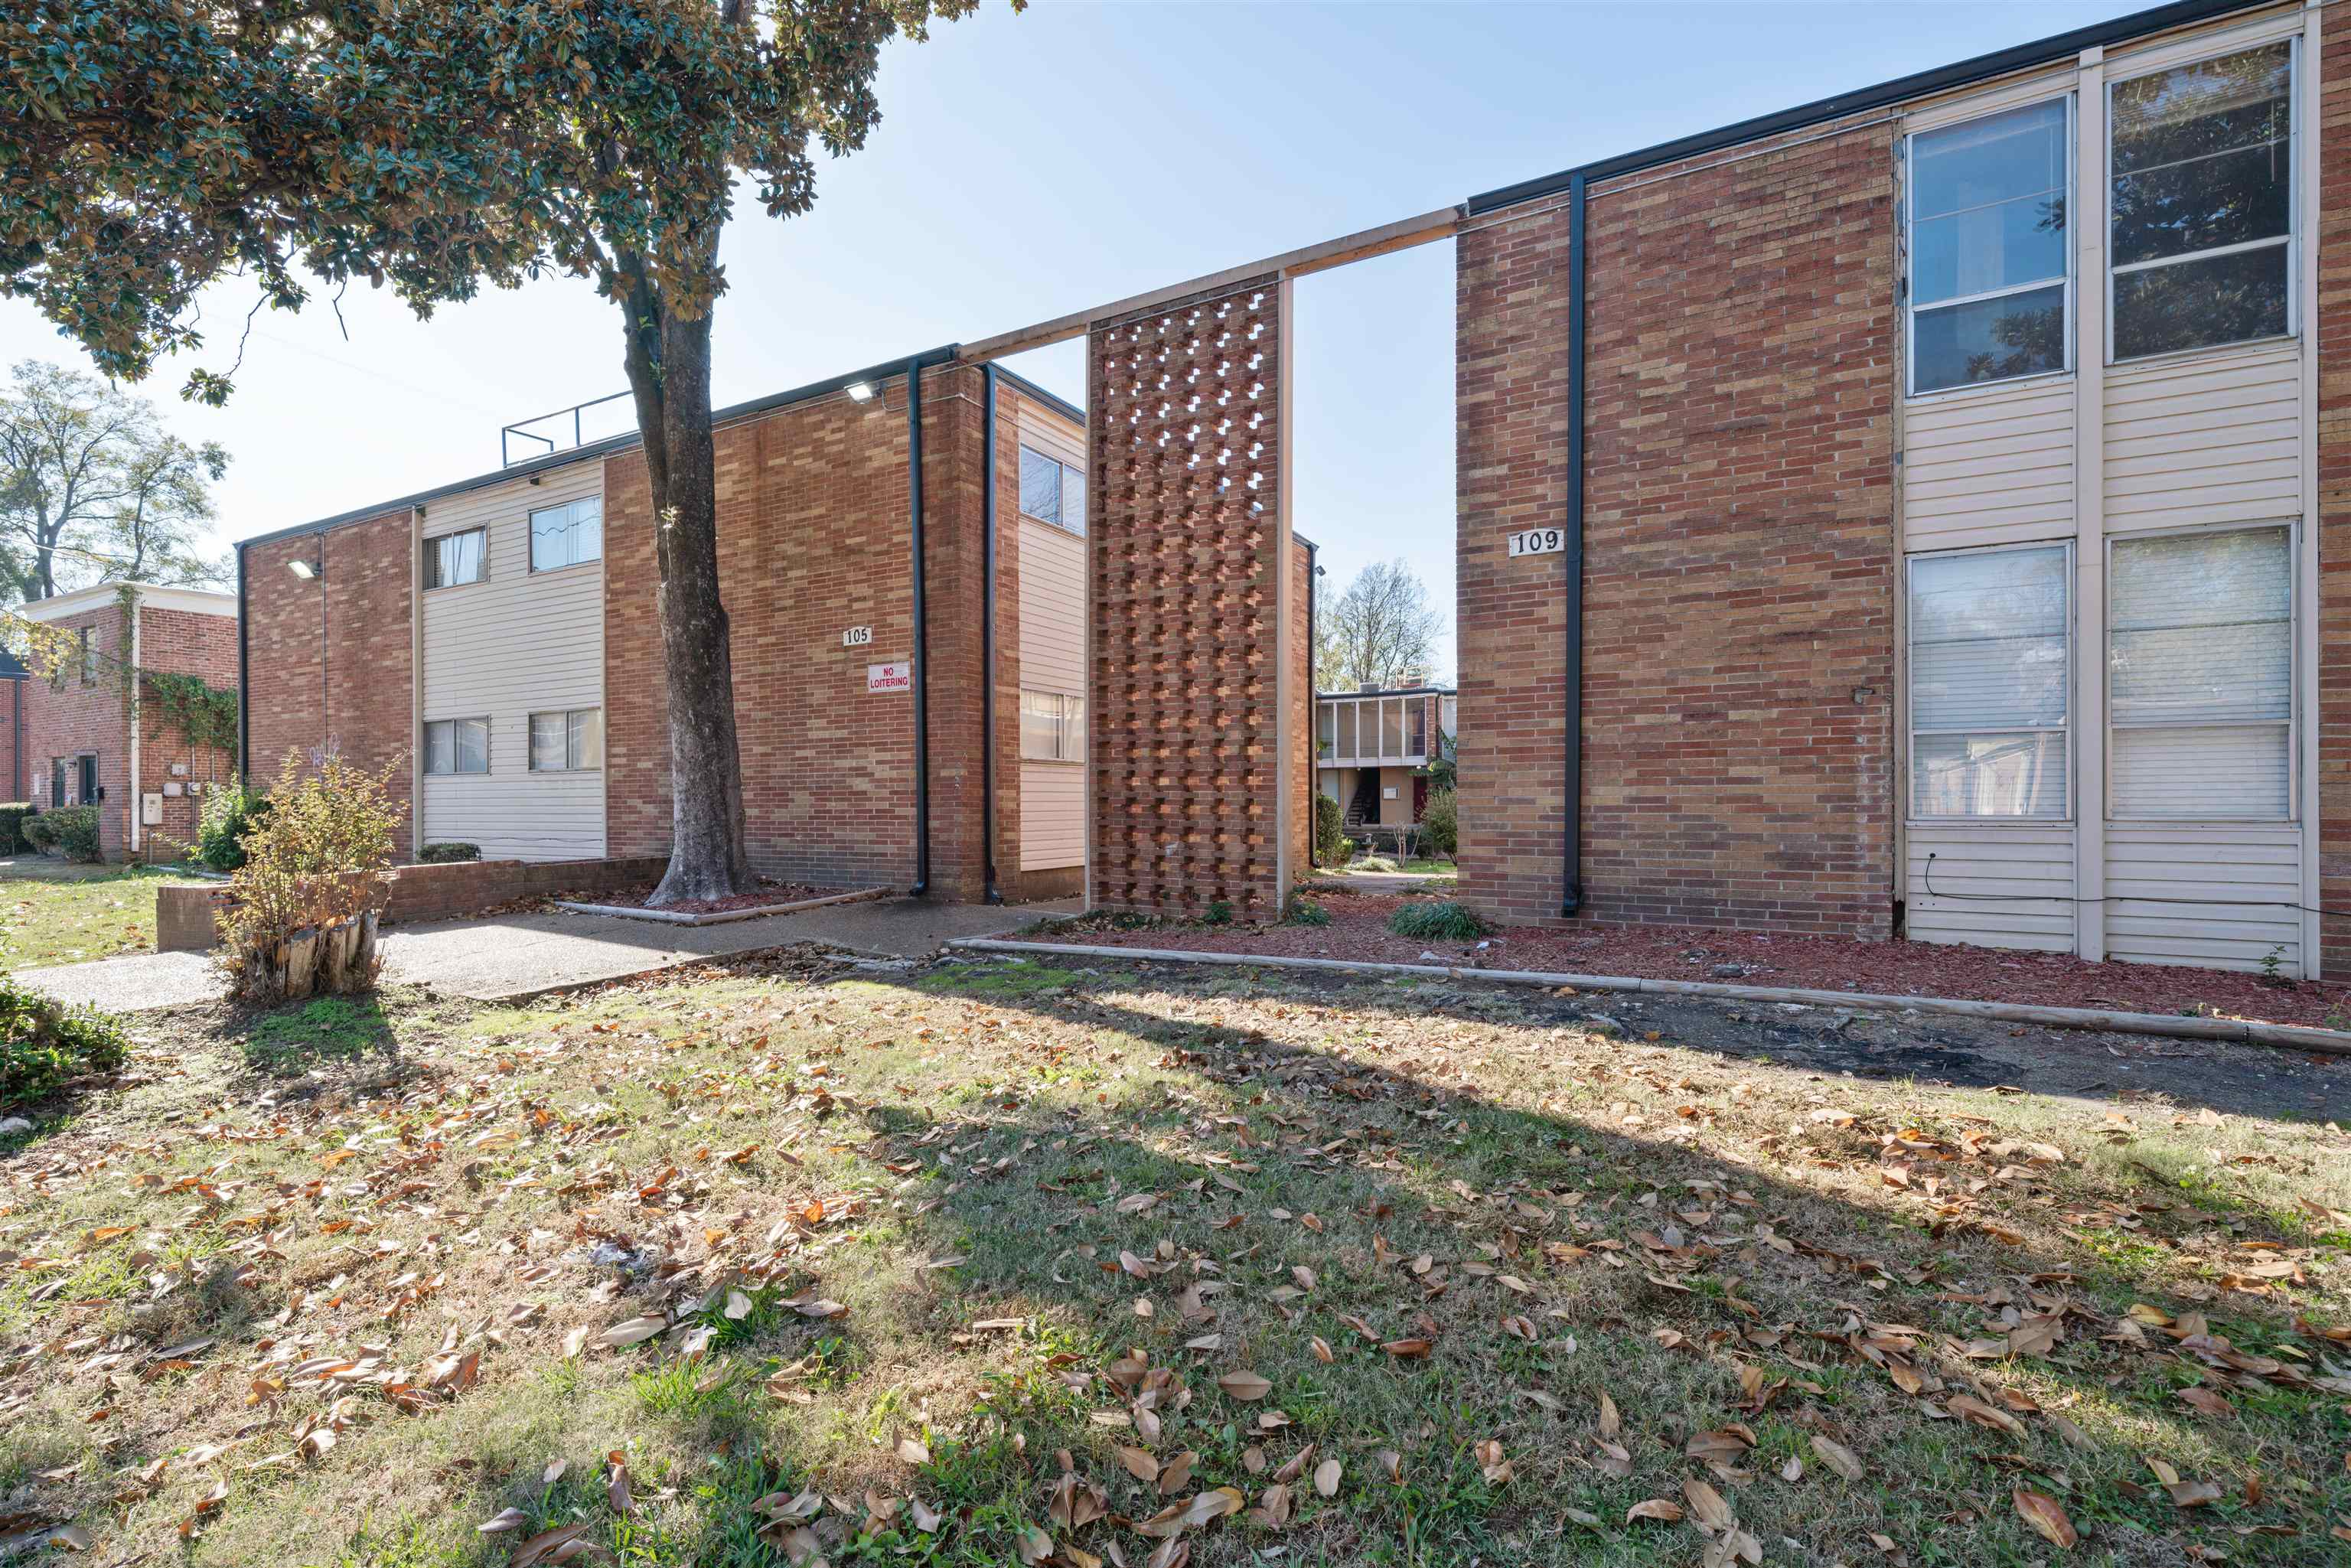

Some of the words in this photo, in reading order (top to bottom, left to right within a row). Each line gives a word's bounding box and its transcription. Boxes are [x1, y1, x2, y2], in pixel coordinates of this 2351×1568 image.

[1518, 530, 1558, 553] 109
[847, 628, 868, 644] 105
[883, 667, 894, 676] NO
[870, 676, 908, 689] LOITERING
